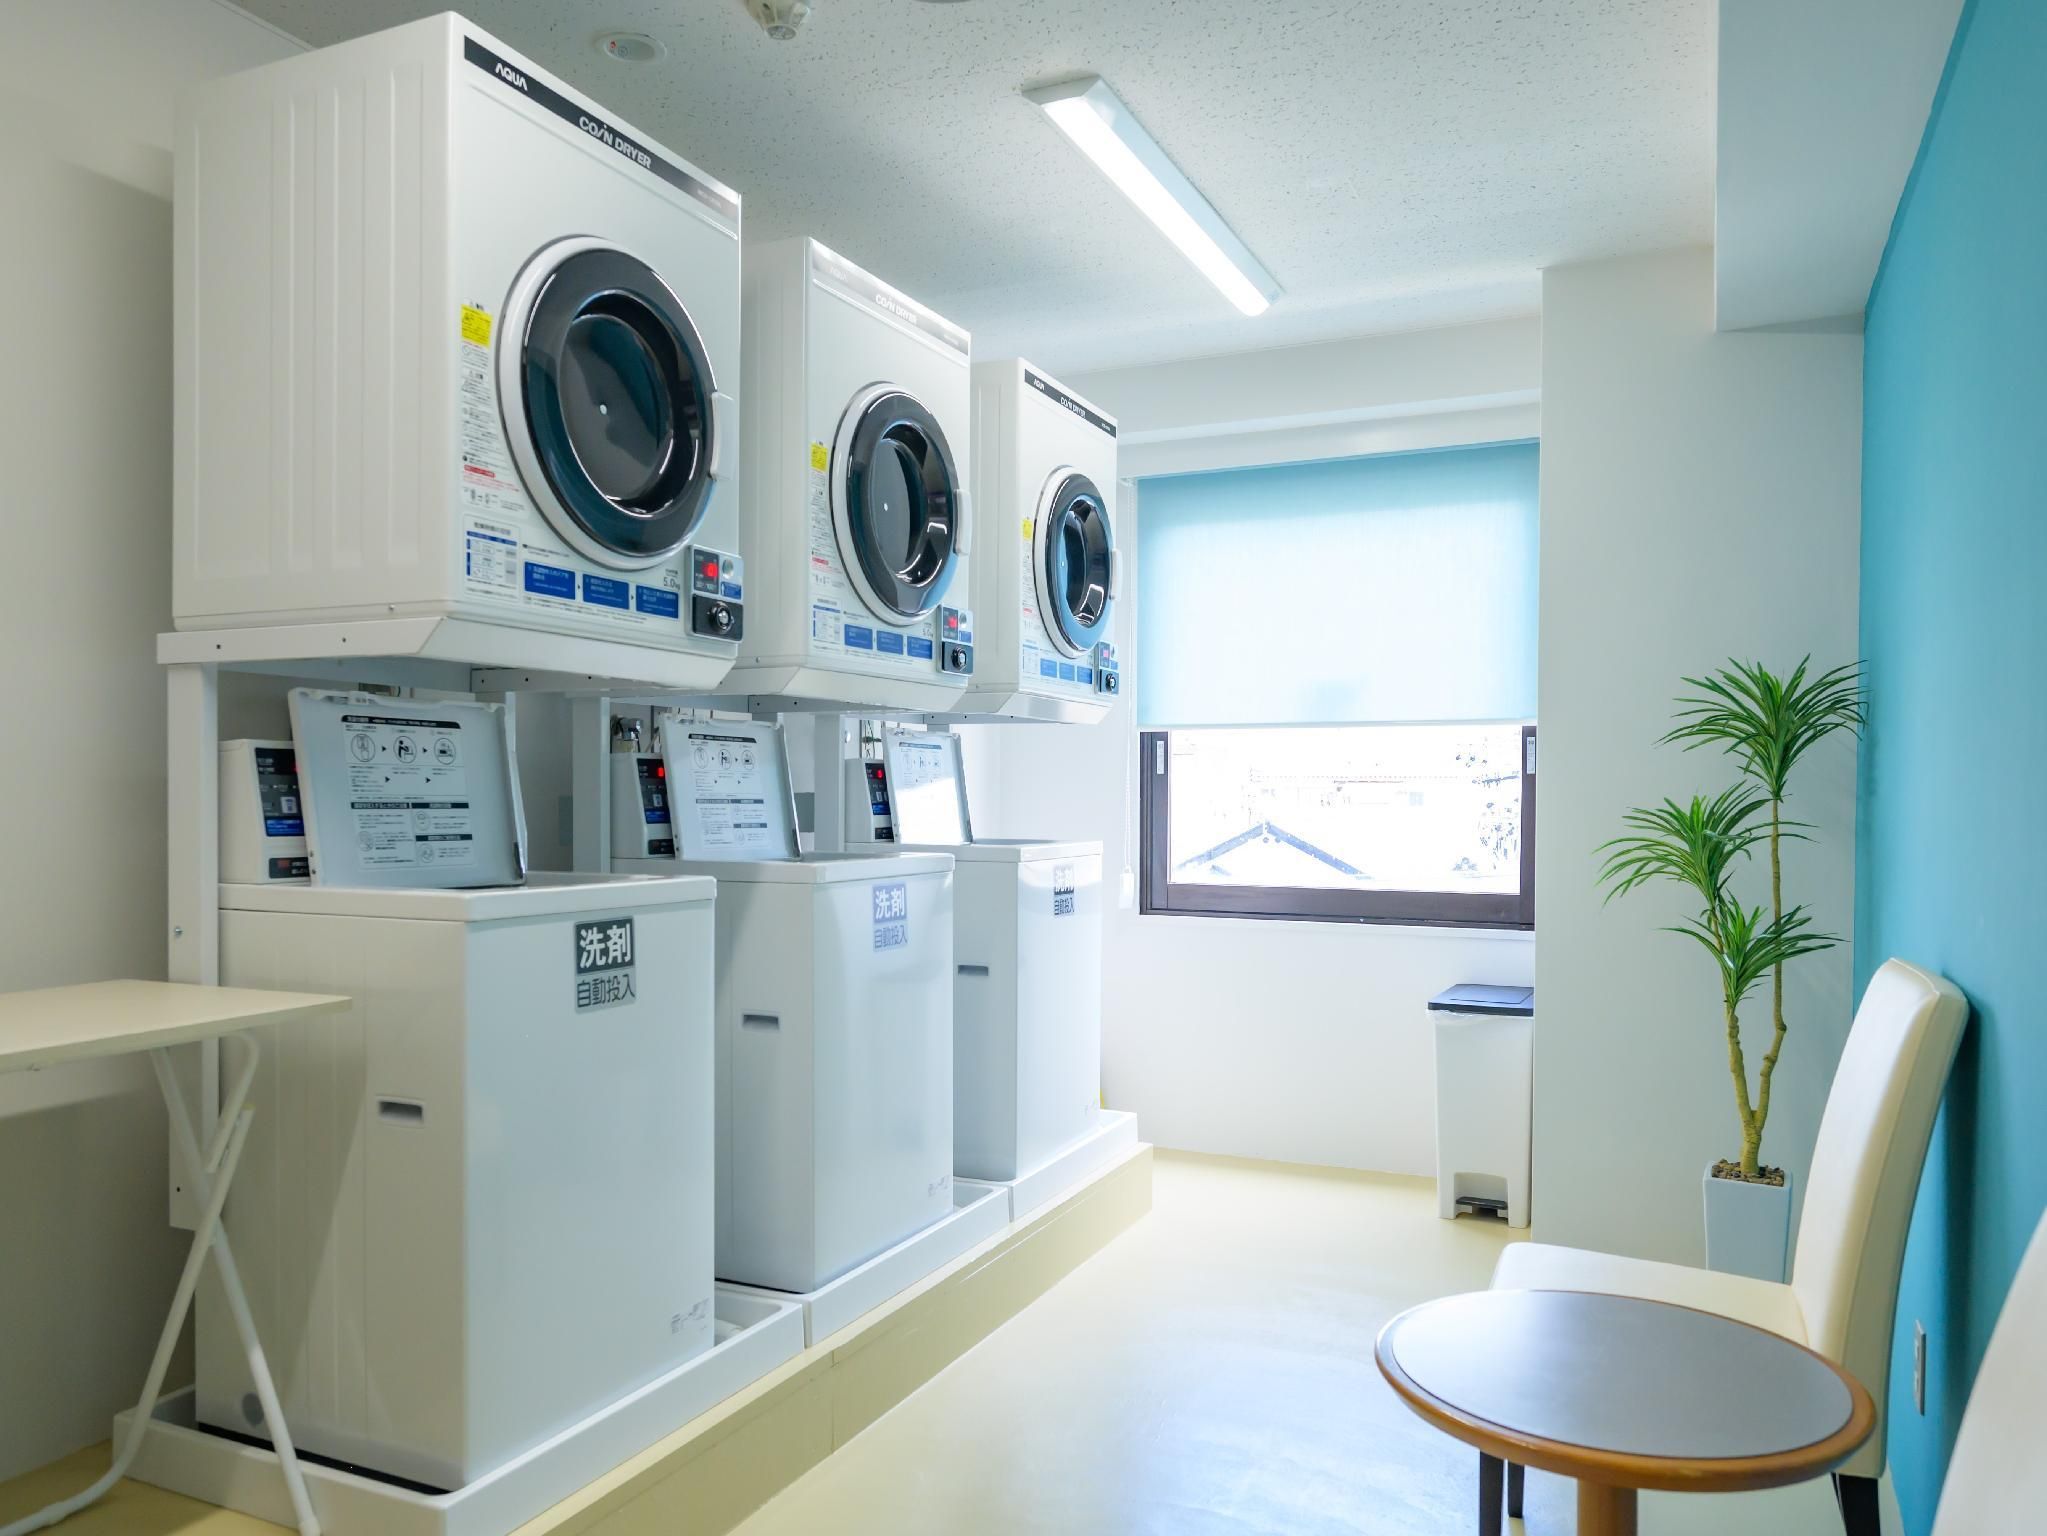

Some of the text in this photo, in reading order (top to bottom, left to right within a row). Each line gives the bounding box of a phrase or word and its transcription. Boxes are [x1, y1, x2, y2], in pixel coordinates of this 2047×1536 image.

[495, 62, 528, 91] AQUA
[579, 115, 651, 169] COIN DRYER
[875, 887, 905, 920] 洗剤
[580, 923, 631, 968] 洗剤
[874, 924, 907, 948] 自動投入
[577, 973, 635, 1008] 自動投入
